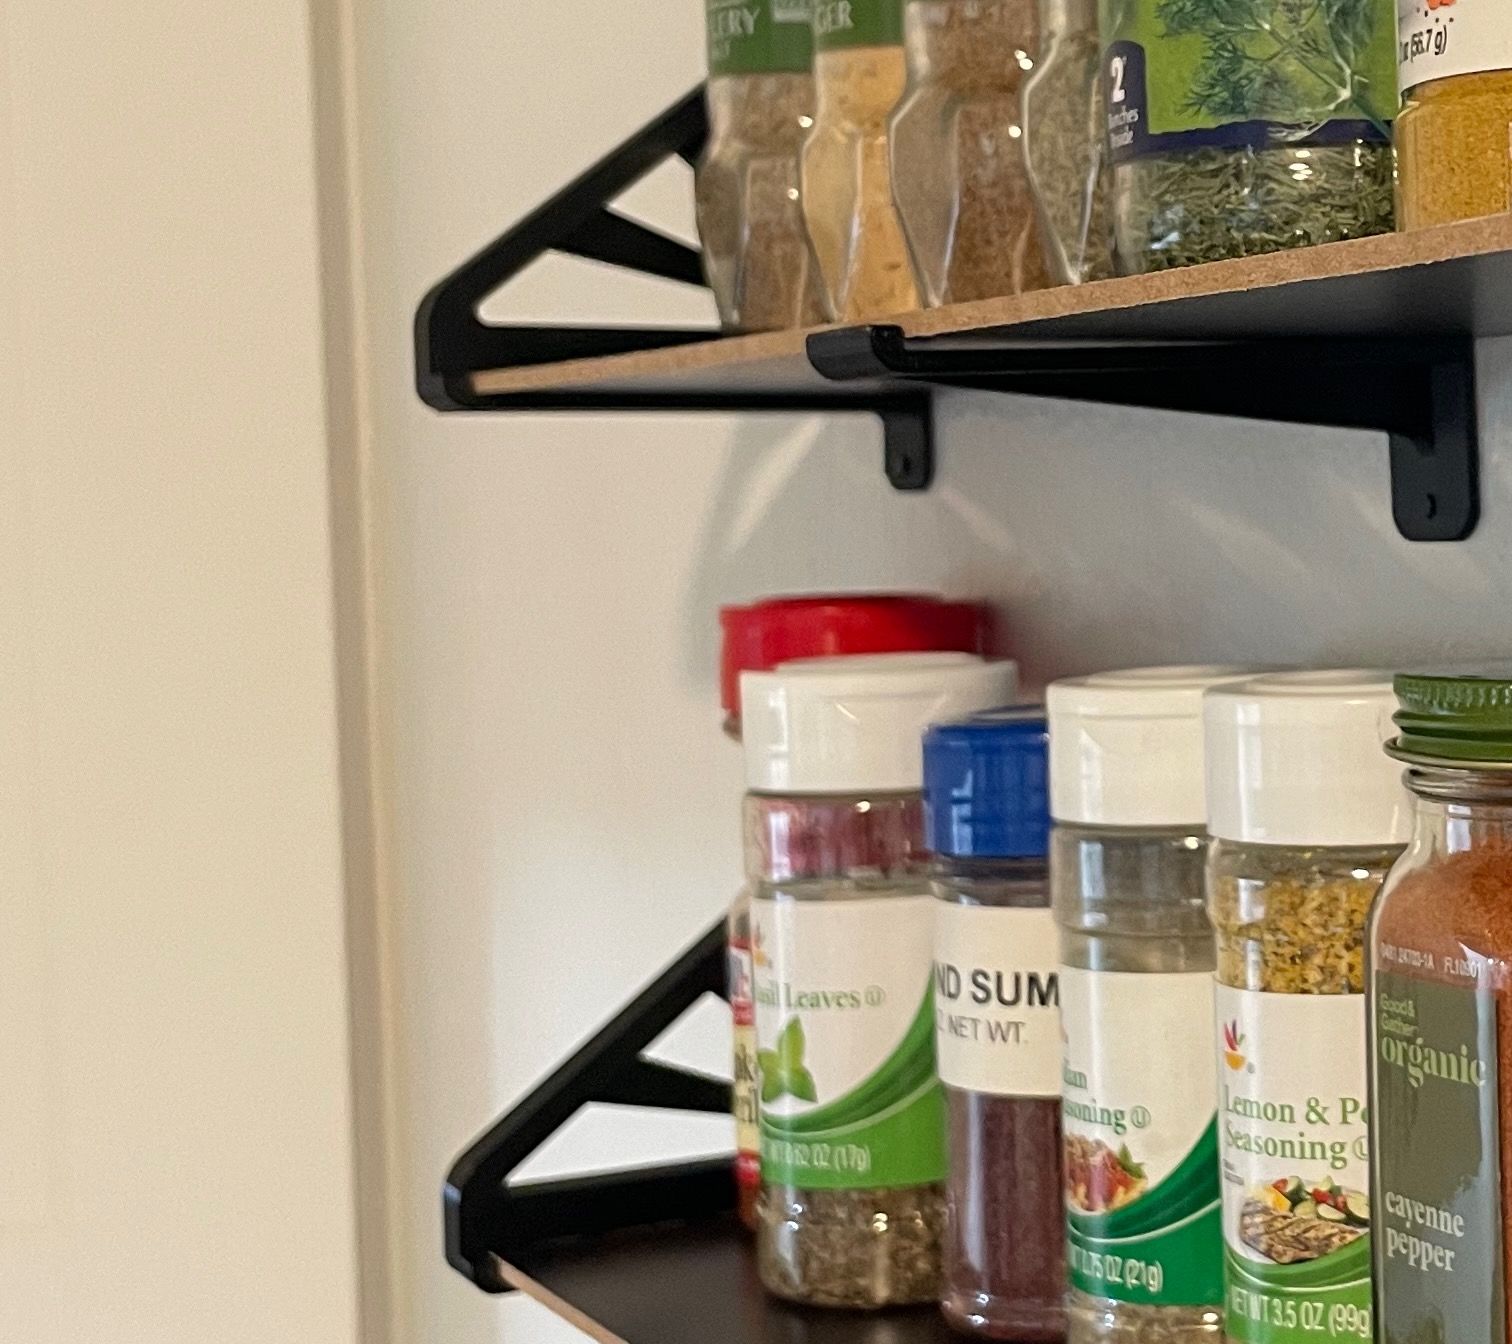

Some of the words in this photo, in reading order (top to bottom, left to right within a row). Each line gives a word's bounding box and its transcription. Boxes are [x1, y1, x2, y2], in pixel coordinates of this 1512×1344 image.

[1381, 1036, 1487, 1088] organic
[1223, 1084, 1297, 1124] Lemon
[1305, 1096, 1331, 1126] &
[1226, 1119, 1348, 1170] Seasoning
[1385, 1191, 1465, 1237] cayenne
[1386, 1227, 1455, 1272] pepper
[1273, 1295, 1298, 1328] 3.5
[1301, 1301, 1326, 1330] OZ
